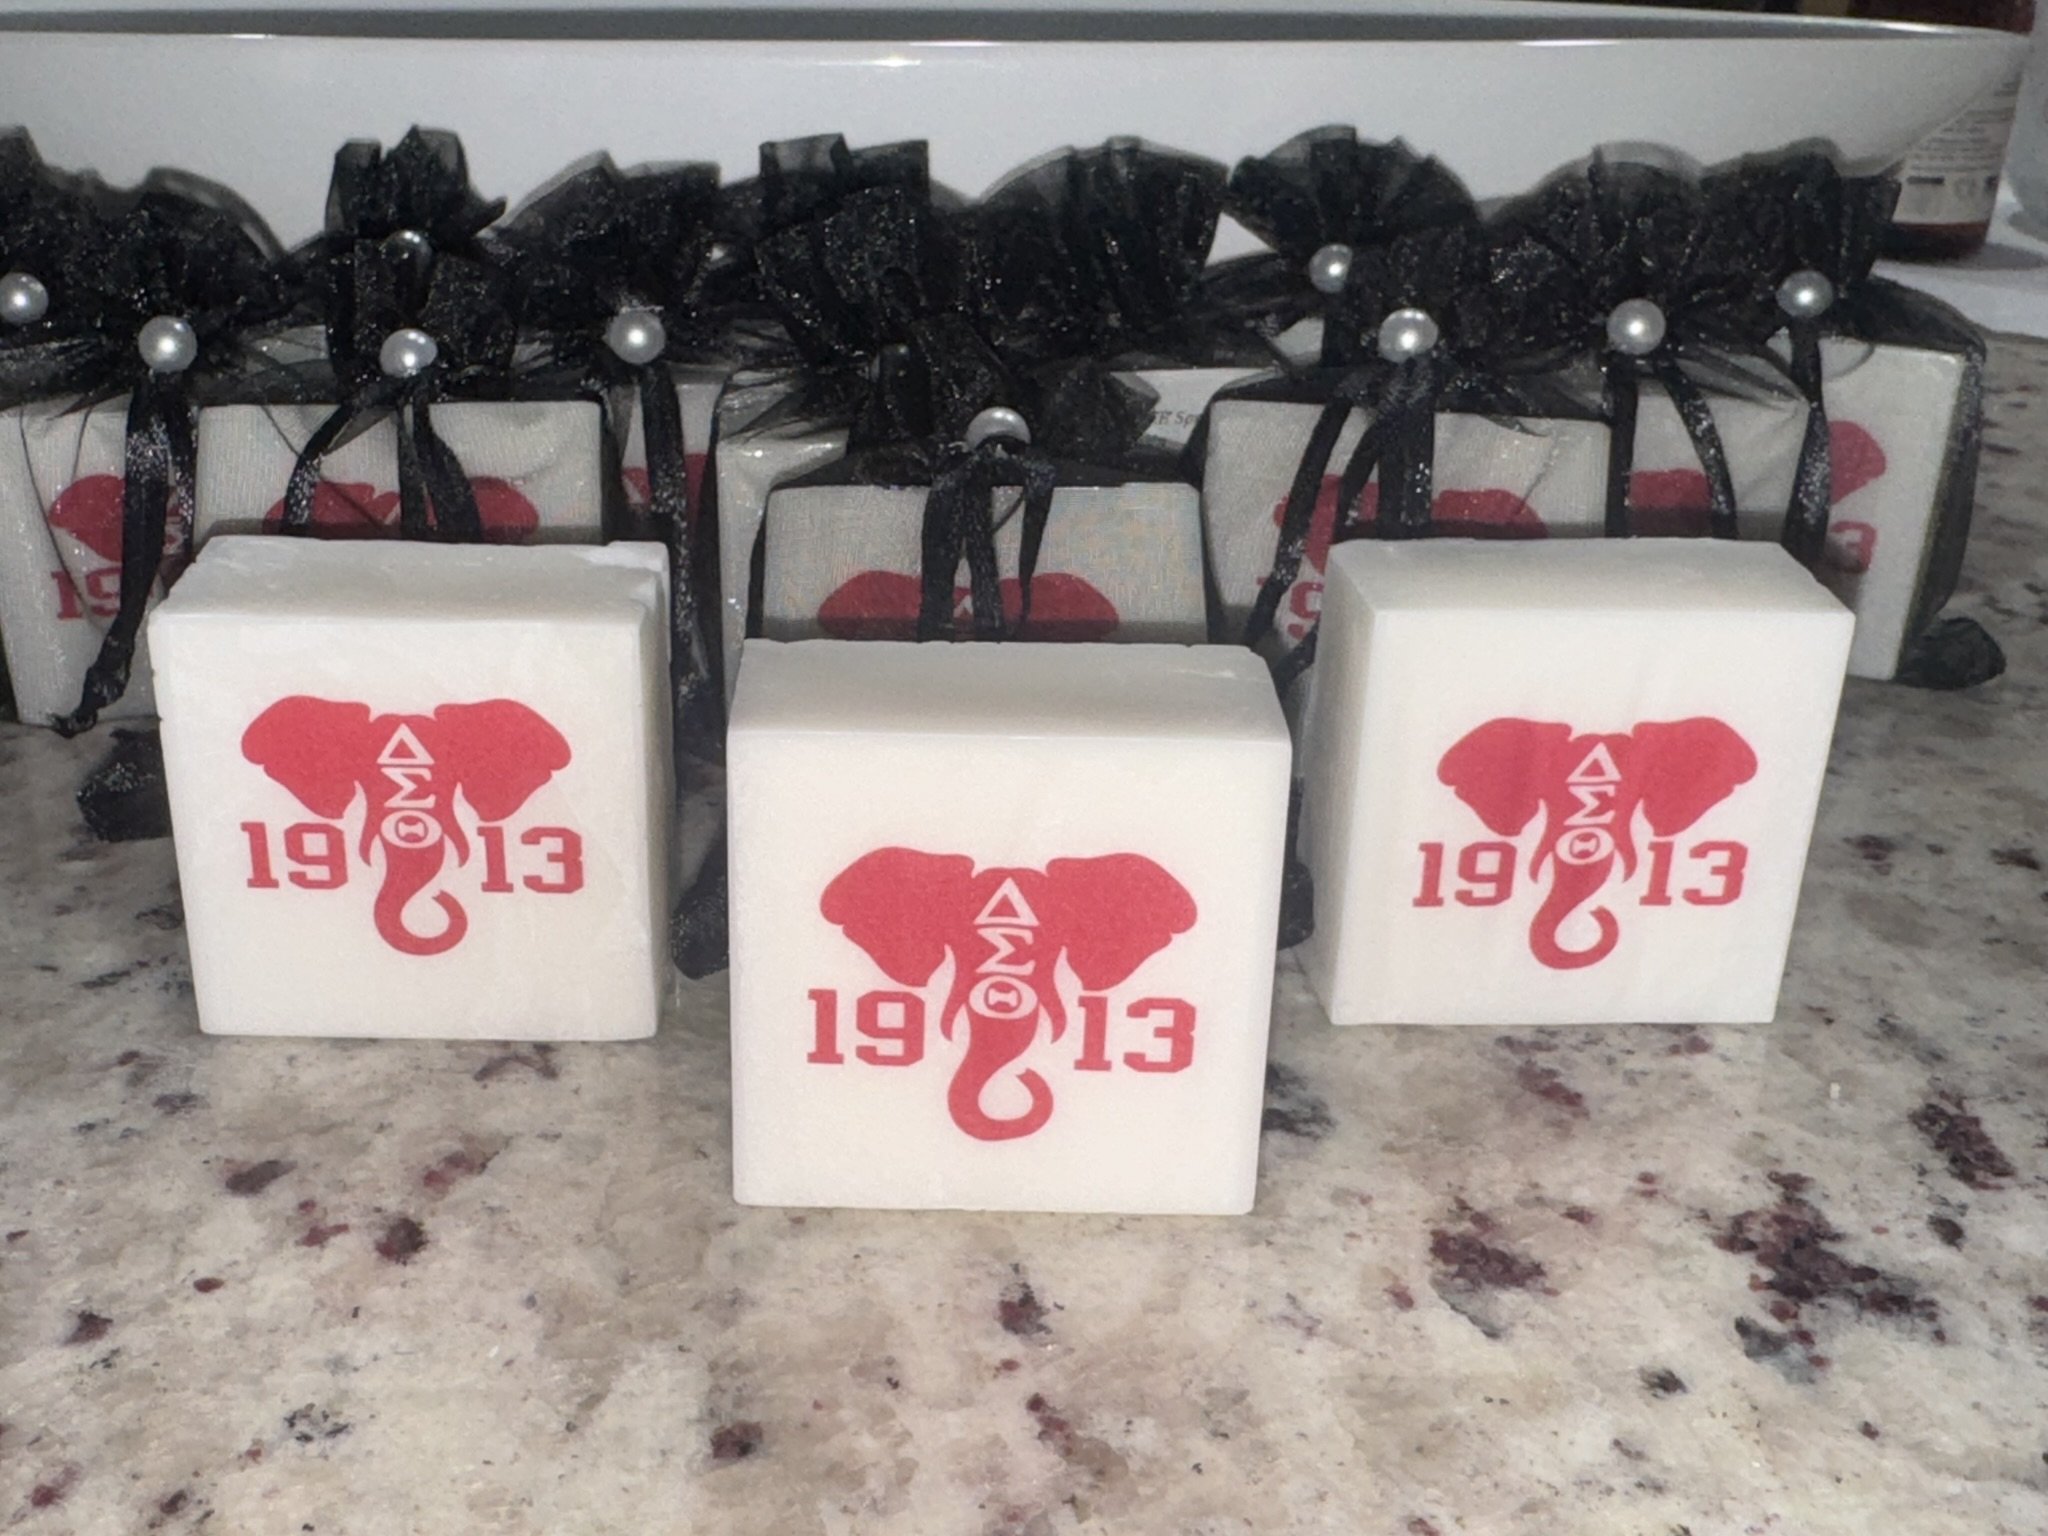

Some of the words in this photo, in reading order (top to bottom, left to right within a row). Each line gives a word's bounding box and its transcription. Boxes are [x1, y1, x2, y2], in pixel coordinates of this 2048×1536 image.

[1829, 520, 1877, 575] 3
[241, 821, 349, 890] 19
[476, 826, 585, 894] 13
[1412, 841, 1518, 907] 19
[1638, 840, 1750, 907] 13
[807, 989, 926, 1067] 19
[1074, 995, 1198, 1074] 13
